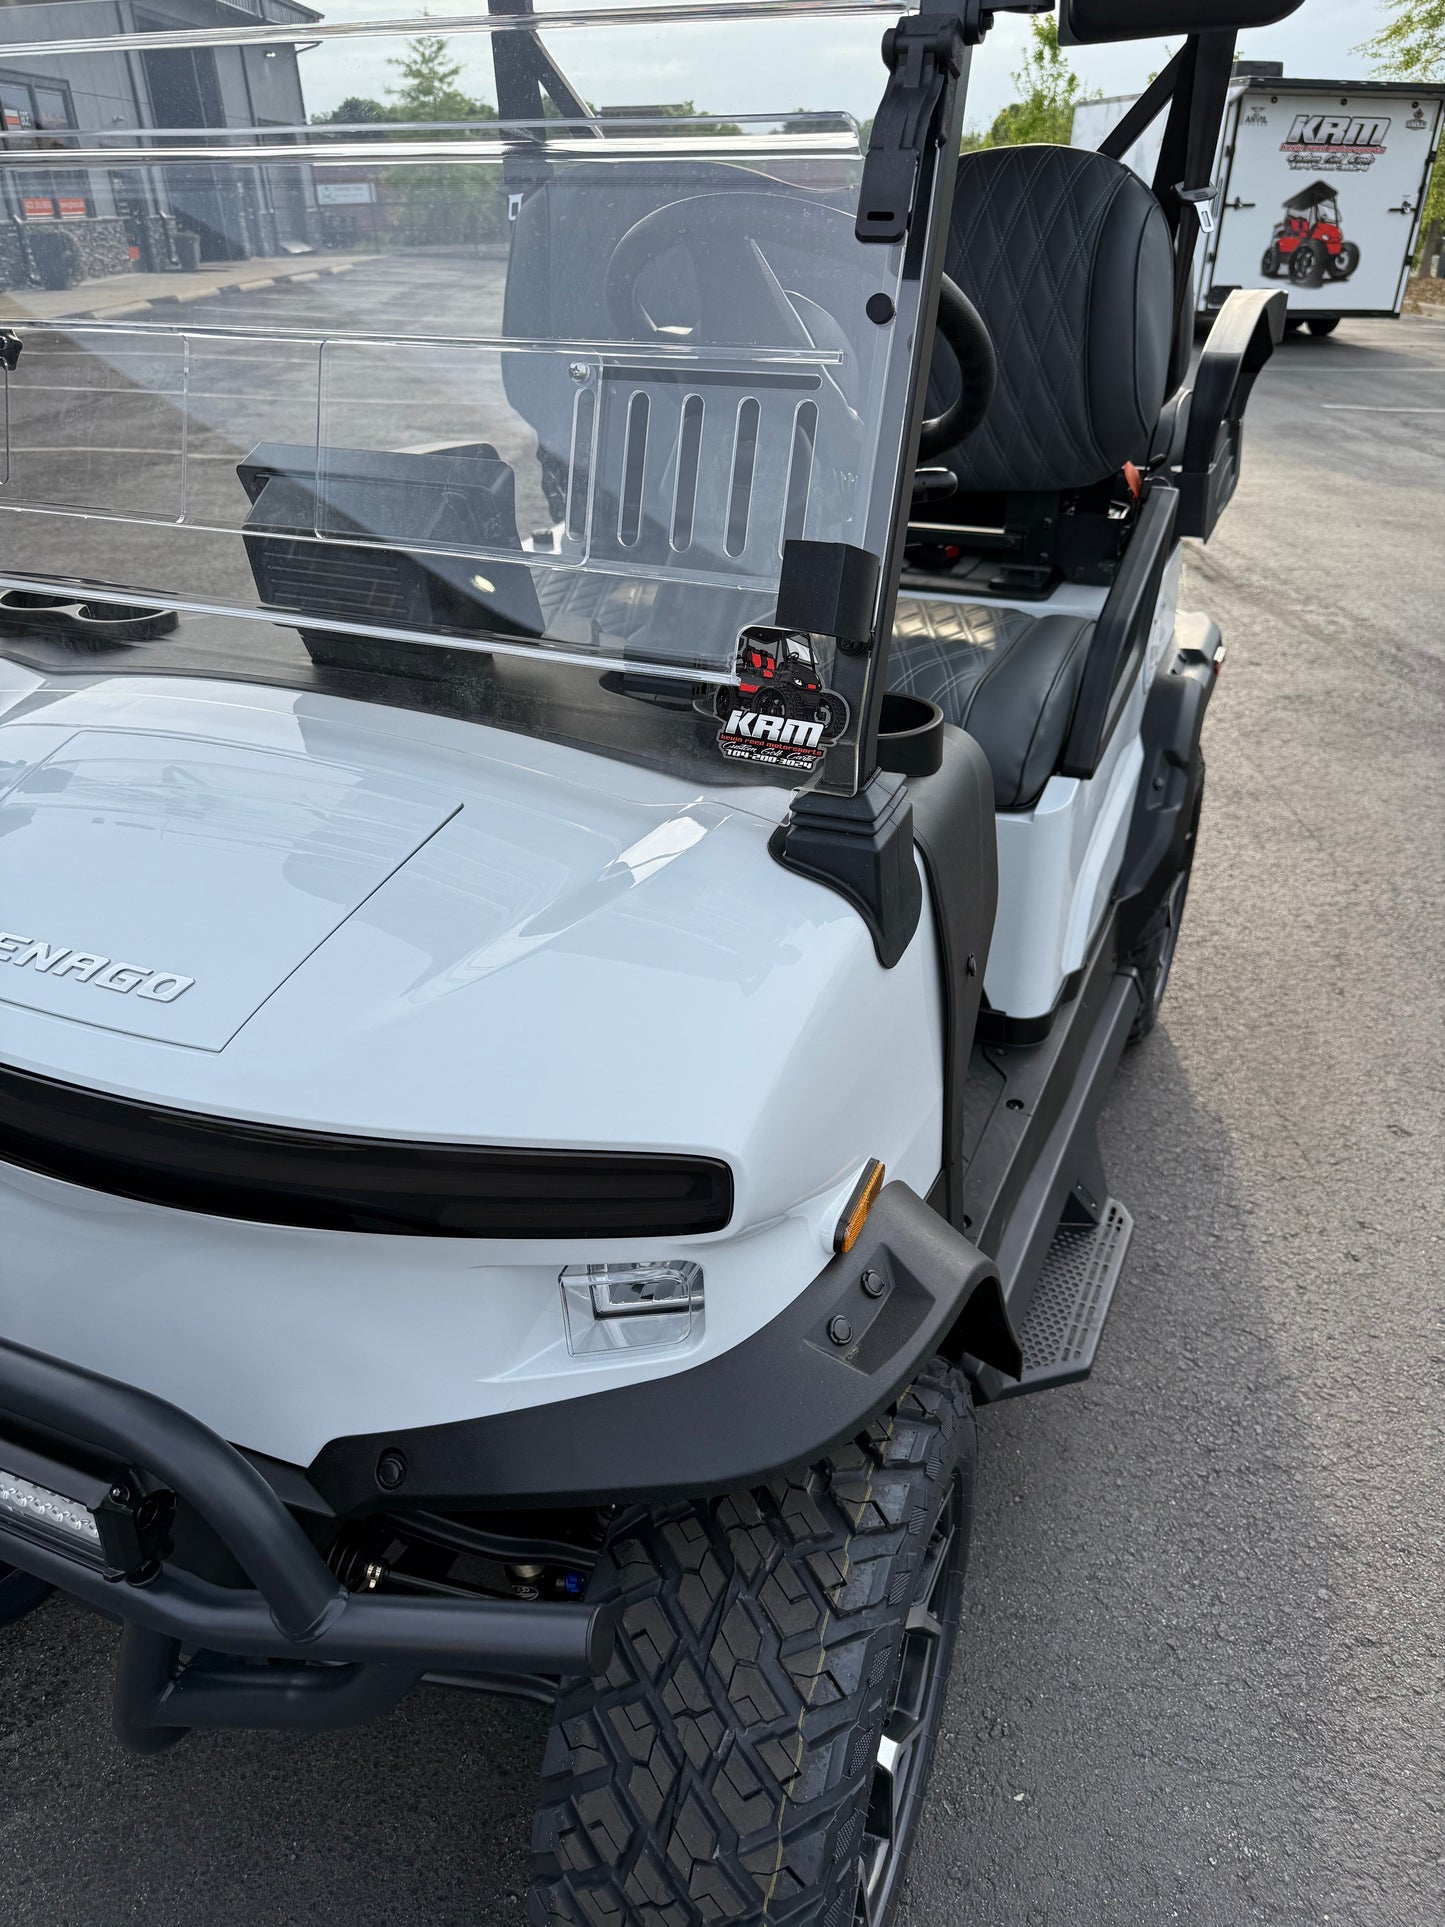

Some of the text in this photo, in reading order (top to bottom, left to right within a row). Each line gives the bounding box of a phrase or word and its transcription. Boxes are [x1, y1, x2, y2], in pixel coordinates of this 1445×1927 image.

[1286, 114, 1392, 145] KRM
[725, 709, 824, 748] KRM
[720, 734, 822, 756] kevin reed motorsports
[722, 741, 757, 753] Custom
[760, 747, 783, 757] Golf
